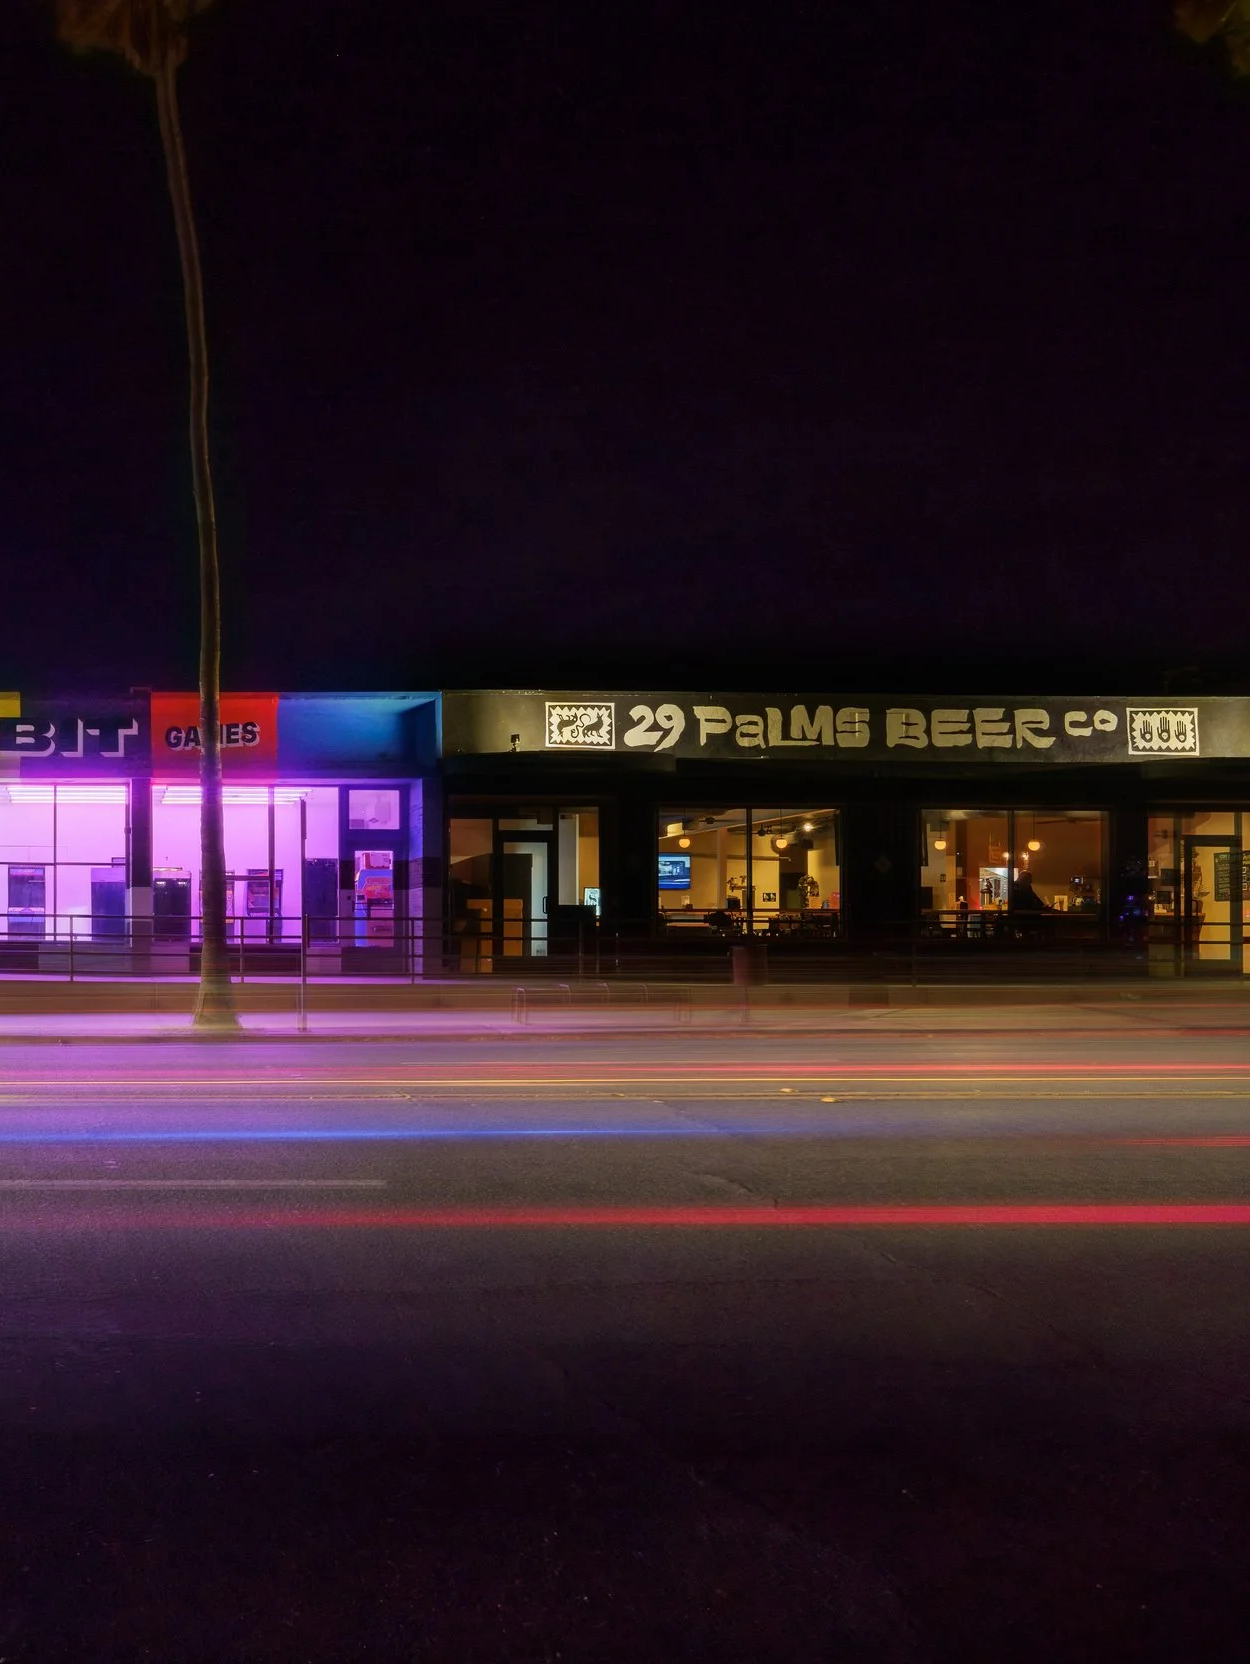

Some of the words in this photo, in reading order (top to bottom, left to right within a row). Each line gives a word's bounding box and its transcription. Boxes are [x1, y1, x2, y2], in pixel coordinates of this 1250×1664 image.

[165, 722, 260, 751] GAES
[623, 705, 686, 752] 29
[886, 708, 1056, 749] BEER
